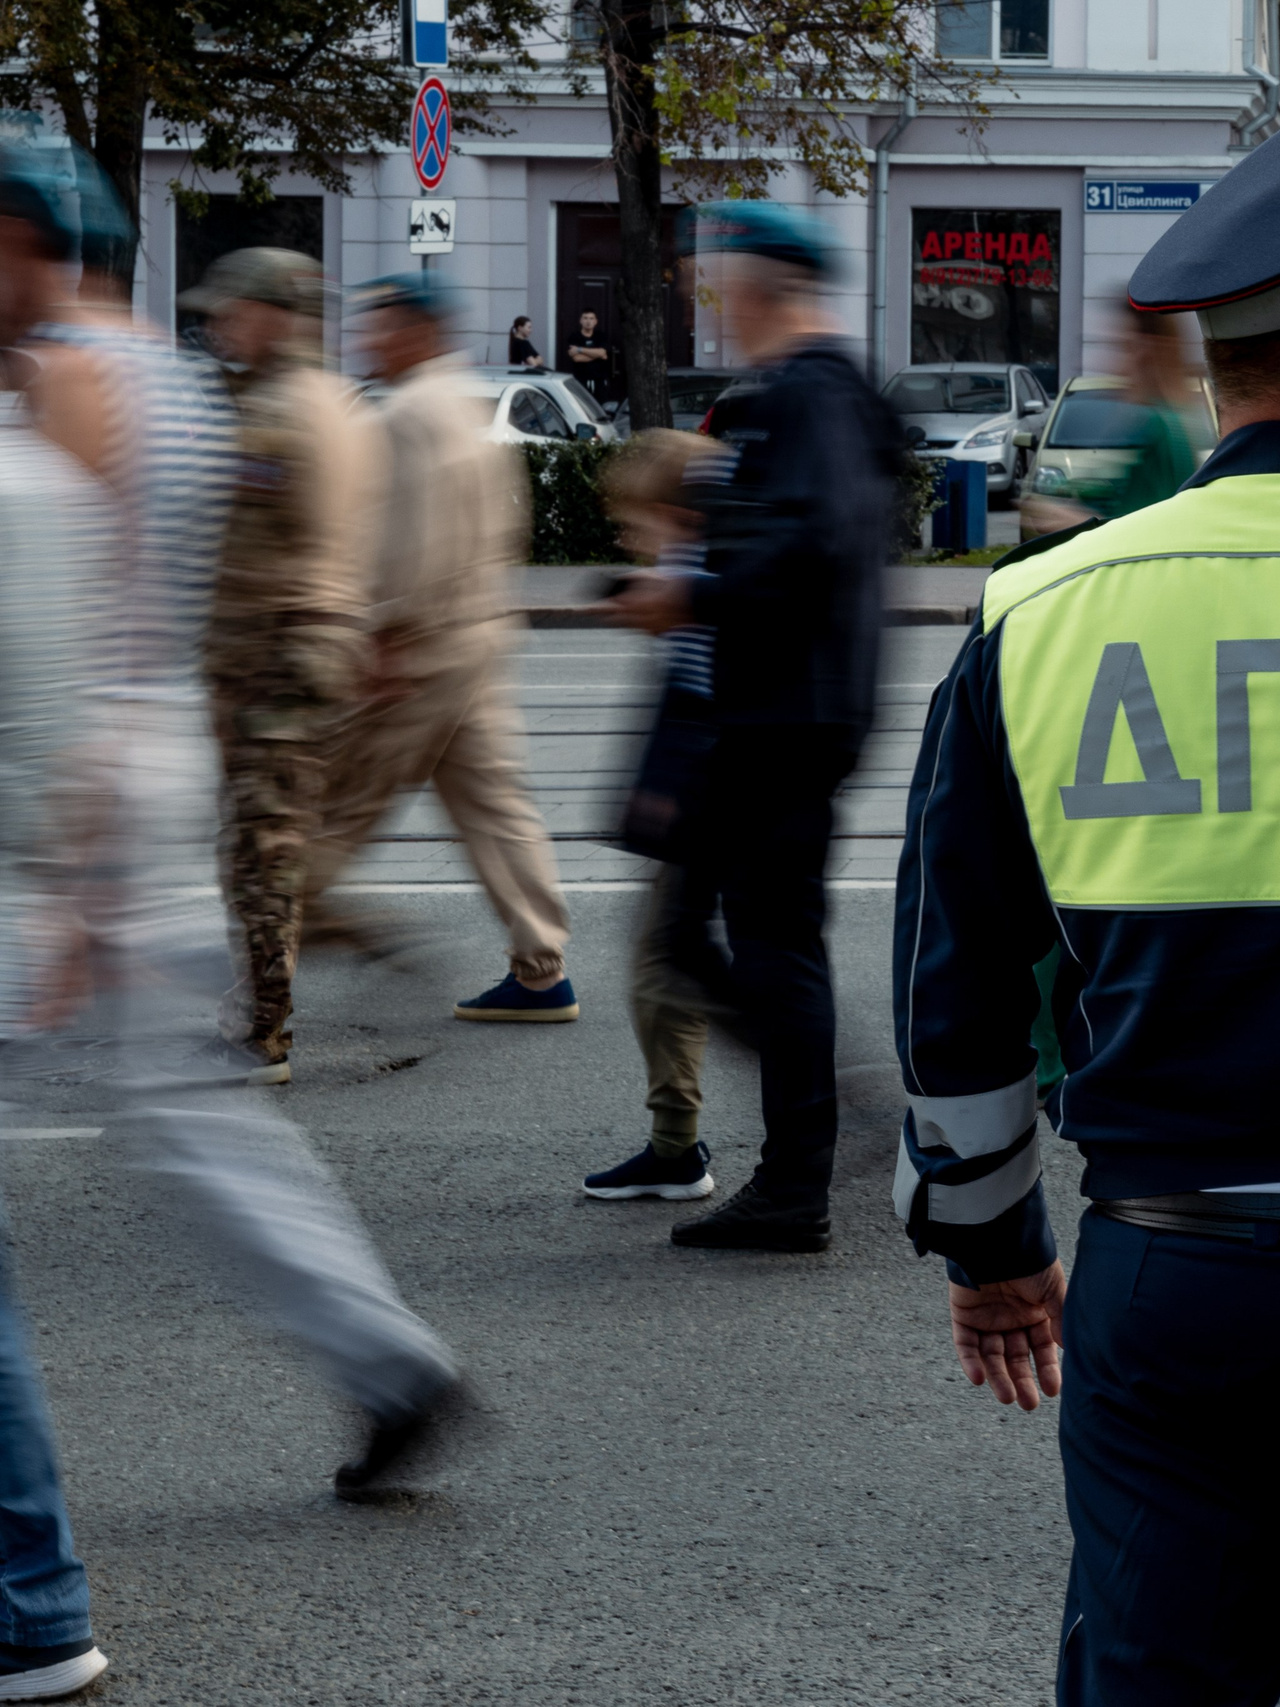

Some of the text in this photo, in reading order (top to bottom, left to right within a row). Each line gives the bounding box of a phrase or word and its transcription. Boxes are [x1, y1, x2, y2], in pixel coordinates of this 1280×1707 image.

[1088, 186, 1111, 206] 31
[1117, 185, 1144, 195] улица
[1117, 195, 1192, 209] Цвиллинга
[921, 230, 1052, 266] АРЕНДА
